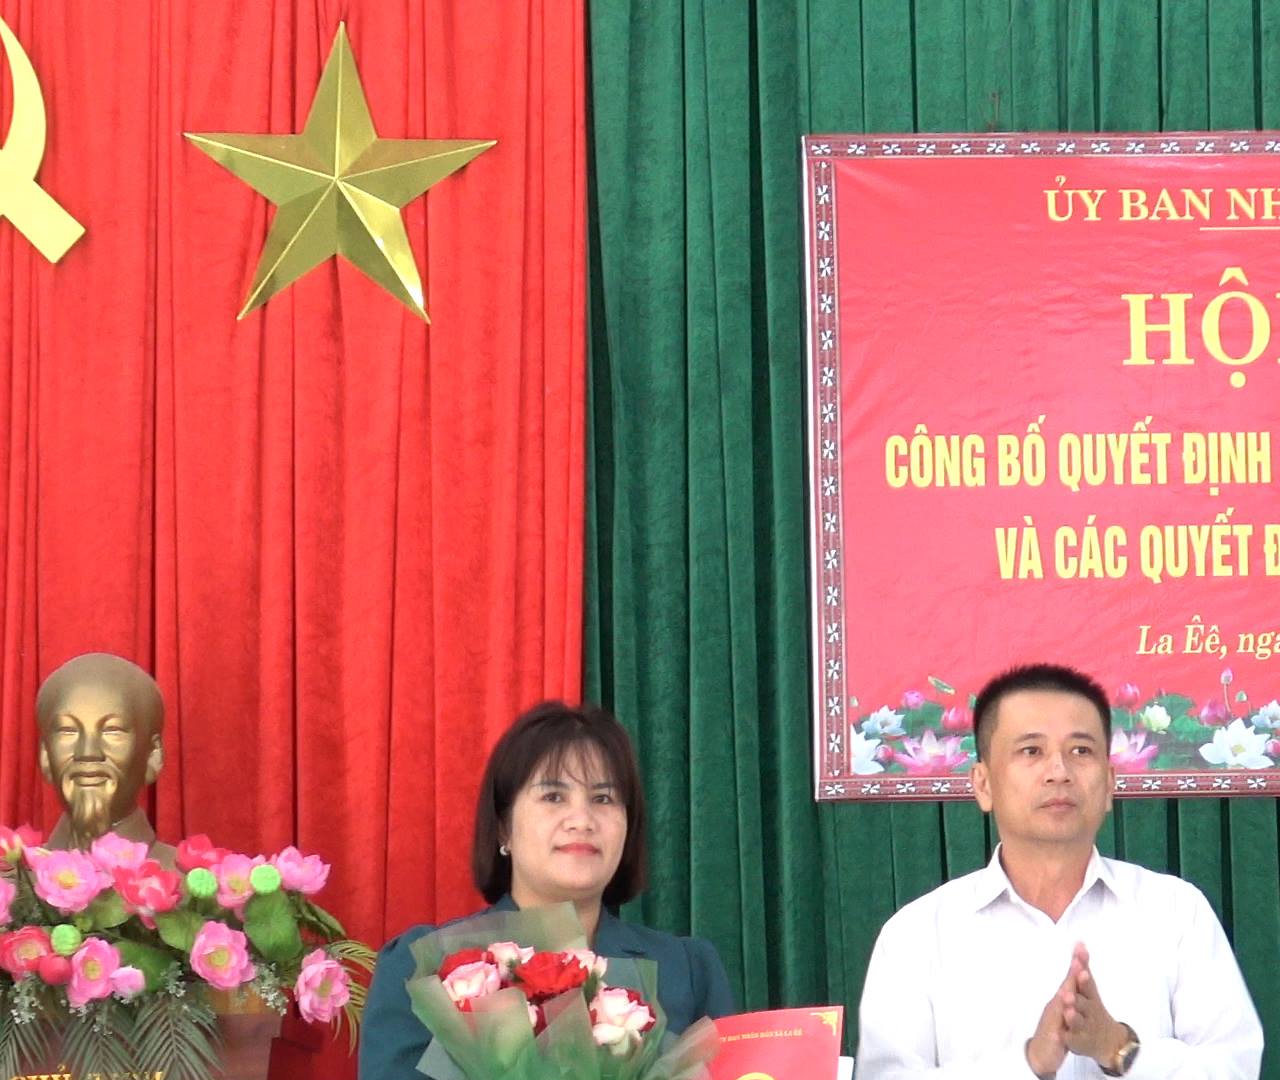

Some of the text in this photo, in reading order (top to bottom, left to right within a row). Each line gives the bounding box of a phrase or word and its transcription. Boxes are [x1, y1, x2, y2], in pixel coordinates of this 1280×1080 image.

[1043, 175, 1107, 222] ỦY
[1118, 188, 1214, 221] BAN
[885, 423, 986, 489] CÔNG
[997, 414, 1047, 487] BỐ
[1058, 415, 1172, 493] QUYẾT
[1181, 431, 1272, 497] ĐỊNH
[994, 515, 1044, 580] VÀ
[1054, 514, 1128, 580] CÁC
[1139, 506, 1254, 585] QUYẾT
[1135, 625, 1174, 656] La
[1182, 614, 1228, 660] Êê,
